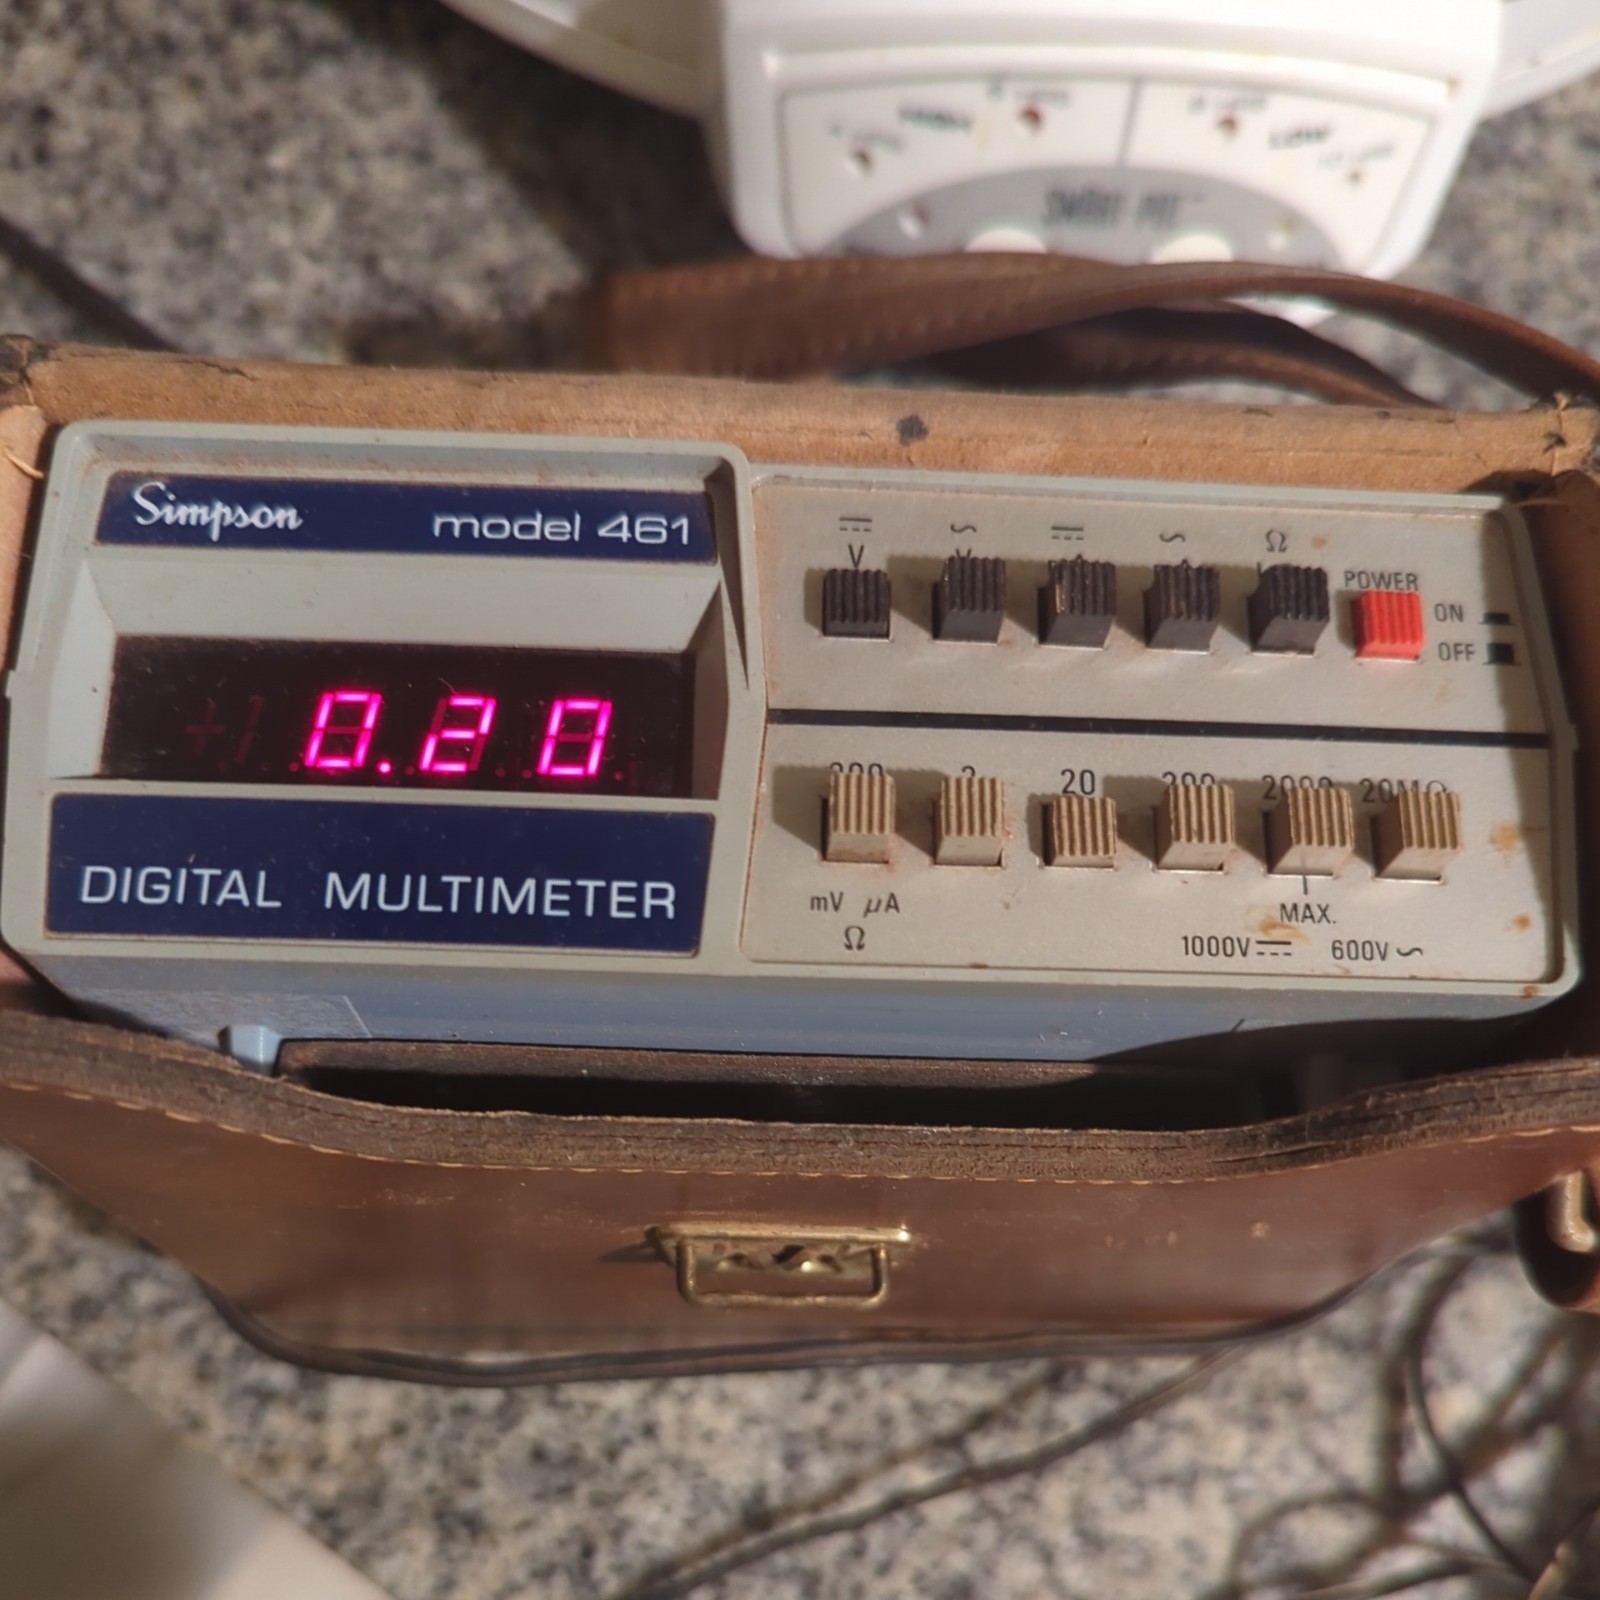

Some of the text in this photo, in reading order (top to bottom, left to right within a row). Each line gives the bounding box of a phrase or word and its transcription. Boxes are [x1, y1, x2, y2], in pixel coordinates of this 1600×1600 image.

[131, 481, 304, 541] Simpson
[432, 512, 692, 545] model 461
[848, 544, 864, 568] V
[1344, 570, 1419, 592] POWER
[1434, 603, 1464, 623] ON
[1438, 642, 1476, 662] OFF
[304, 691, 613, 777] 0.20
[1060, 768, 1096, 796] 20
[80, 865, 677, 920] DIGITAL MULTIMETER
[810, 891, 844, 912] mV
[1279, 903, 1337, 925] MAX.
[1181, 935, 1250, 958] 1000V
[1331, 940, 1389, 962] 600V
